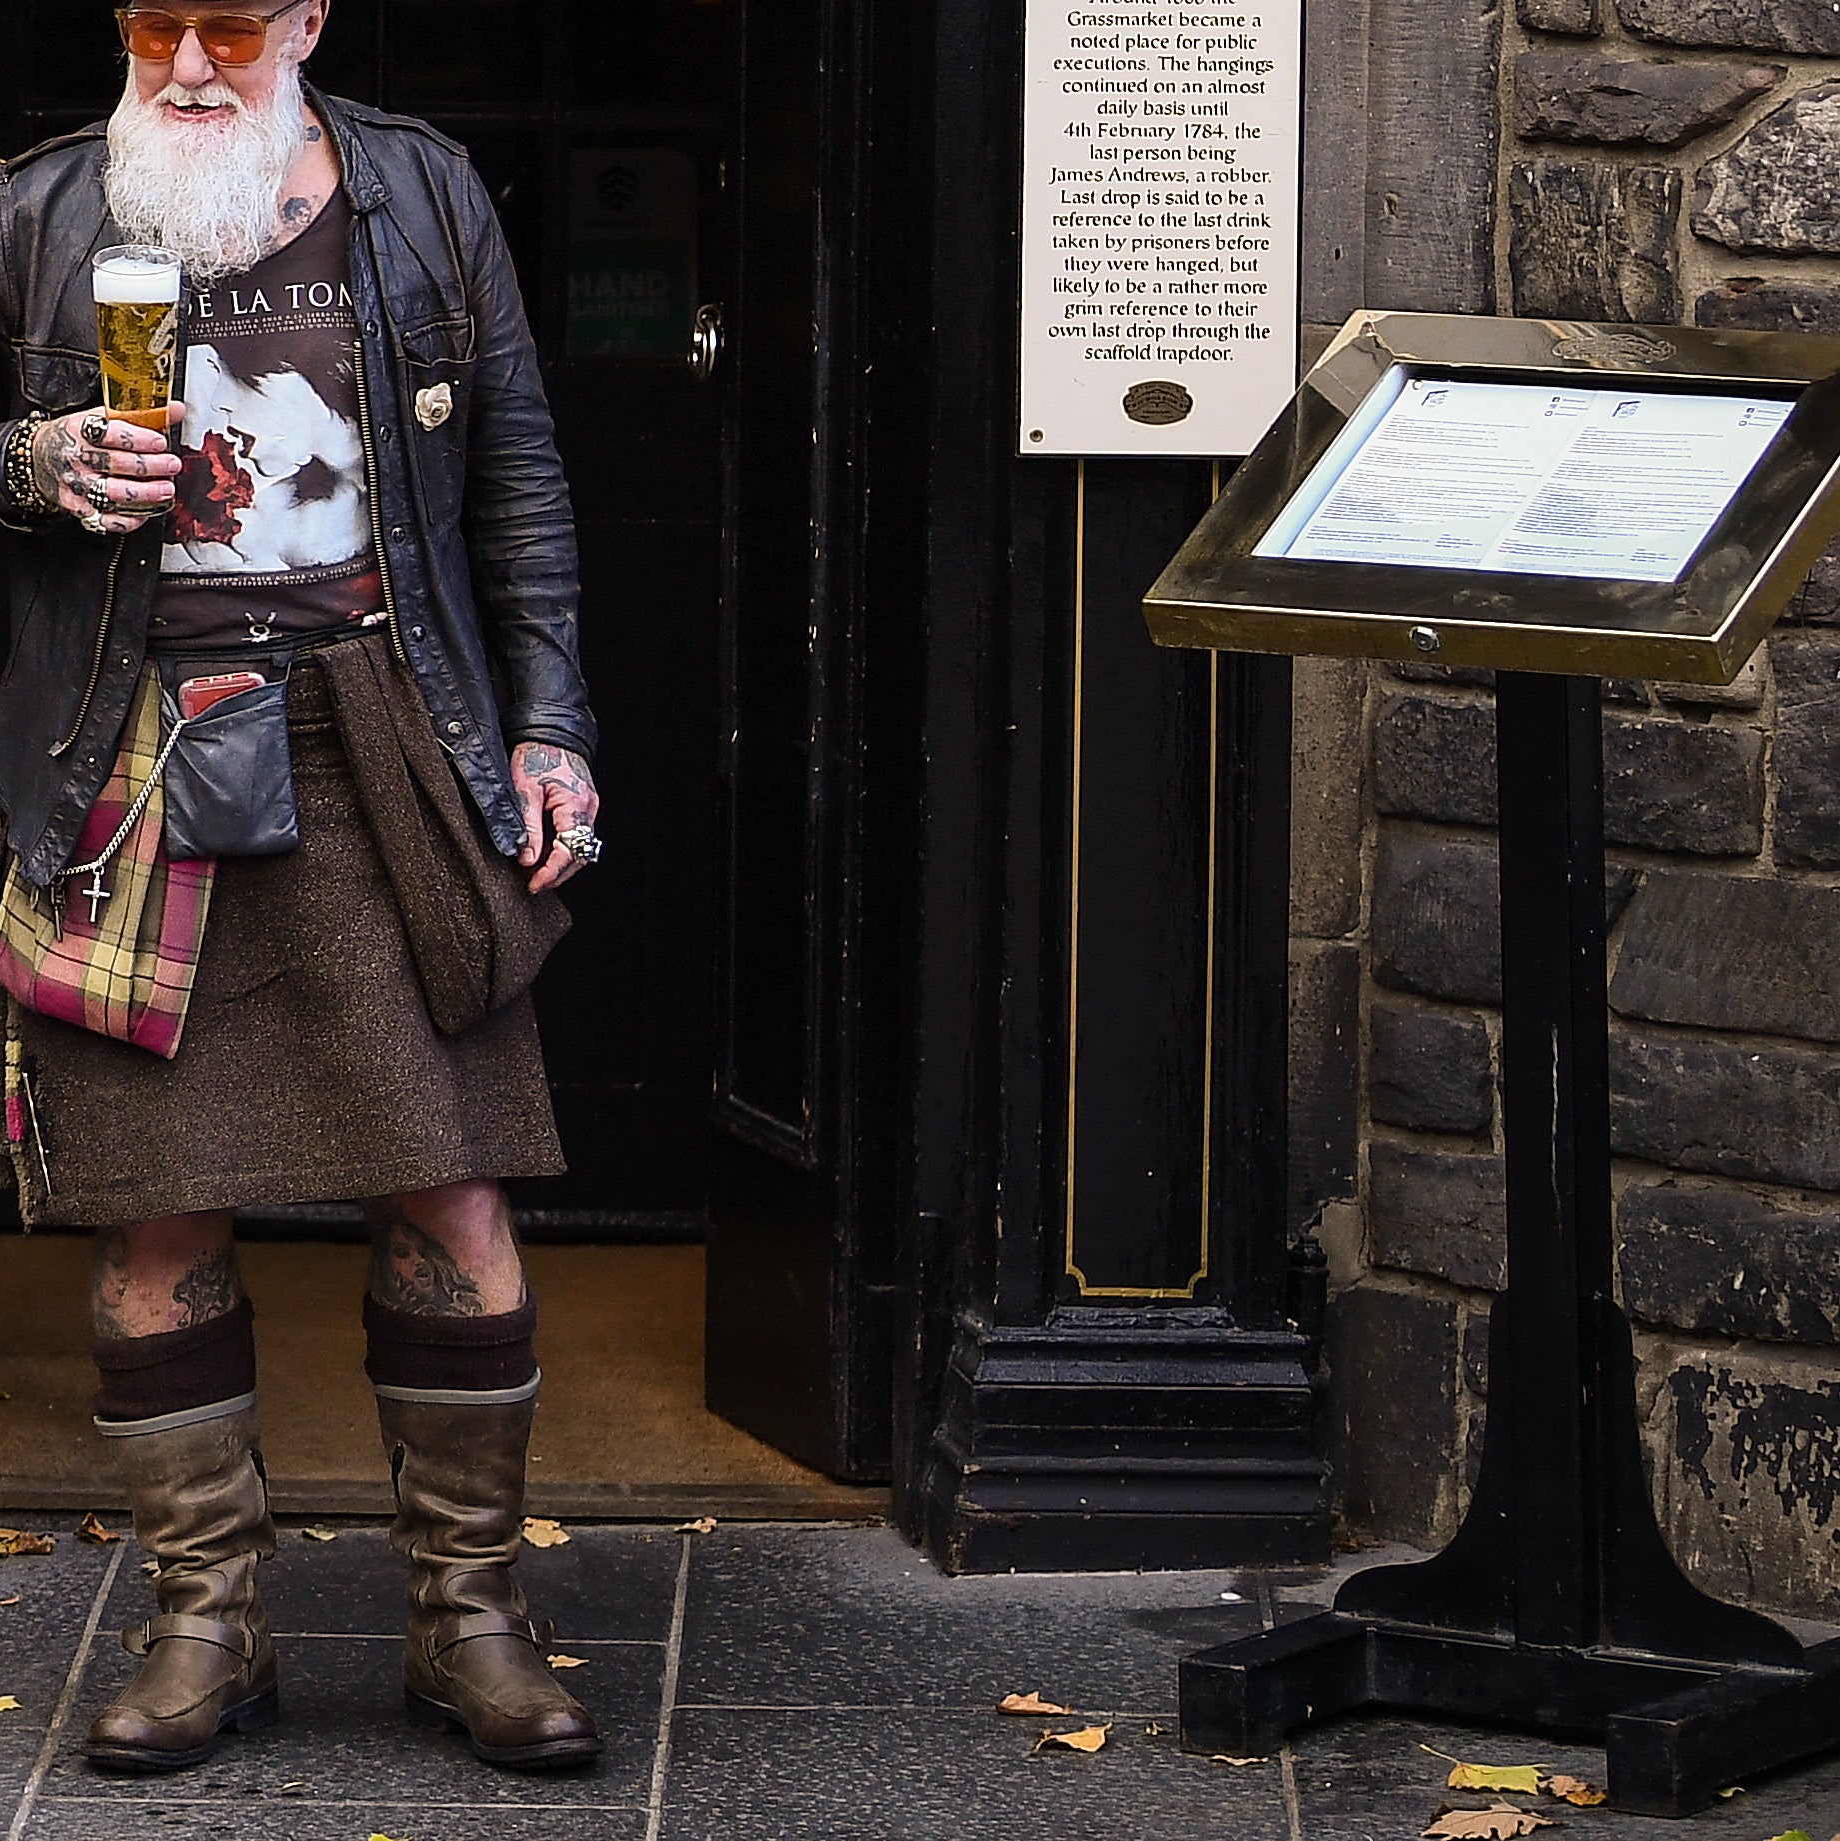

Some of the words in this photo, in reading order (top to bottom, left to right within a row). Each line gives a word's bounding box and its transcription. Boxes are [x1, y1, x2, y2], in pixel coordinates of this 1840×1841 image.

[1068, 11, 1172, 26] Grassmarket
[1179, 12, 1245, 27] became
[1252, 17, 1261, 27] a
[1071, 34, 1119, 48] noted
[1126, 34, 1169, 53] place
[1177, 34, 1201, 49] for
[1206, 34, 1257, 54] public
[1054, 56, 1150, 71] executions.
[1158, 56, 1190, 71] The
[1198, 56, 1274, 76] hangings
[1063, 78, 1147, 93] continued
[1154, 82, 1175, 93] on
[1182, 83, 1202, 93] an
[1208, 79, 1265, 94] almost
[1097, 99, 1138, 118] daily
[1144, 100, 1185, 116] basis
[1191, 101, 1228, 116] until
[1064, 122, 1090, 137] 4th
[1098, 123, 1175, 141] February
[1235, 122, 1260, 139] the
[1090, 144, 1118, 160] last
[1124, 148, 1181, 164] person
[1188, 145, 1236, 164] being
[1049, 167, 1103, 185] James
[1108, 167, 1189, 184] Andrews,
[1196, 171, 1205, 182] a
[1211, 168, 1271, 183] robber.
[1061, 190, 1095, 204] Last
[1102, 189, 1140, 209] drop
[1147, 189, 1160, 205] is
[1165, 190, 1199, 205] said
[1205, 191, 1222, 205] to
[1229, 190, 1248, 205] be
[1255, 194, 1264, 205] a
[1053, 211, 1131, 227] reference
[1138, 213, 1154, 227] to
[1161, 212, 1187, 227] the
[1194, 212, 1222, 227] last
[1227, 212, 1271, 228] drink
[1053, 234, 1098, 248] taken
[1106, 234, 1127, 252] by
[1132, 234, 1210, 253] prisoners
[1215, 234, 1269, 250] before
[1065, 256, 1101, 274] they
[1107, 260, 1149, 271] were
[1156, 256, 1223, 275] hanged,
[1231, 257, 1257, 272] but
[1054, 277, 1099, 297] likely
[1105, 279, 1120, 293] to
[1126, 278, 1146, 293] be
[1153, 283, 1162, 293] a
[1169, 279, 1219, 294] rather
[1224, 283, 1267, 294] more
[230, 288, 273, 315] LA
[1064, 300, 1102, 319] grim
[1110, 300, 1188, 316] reference
[1195, 303, 1211, 316] to
[1218, 301, 1258, 316] their
[1049, 326, 1086, 337] own
[1093, 322, 1120, 337] last
[1127, 323, 1165, 342] drop
[1173, 323, 1238, 342] through
[1245, 323, 1270, 339] the
[1085, 344, 1151, 360] scaffold
[1157, 345, 1233, 364] trapdoor.
